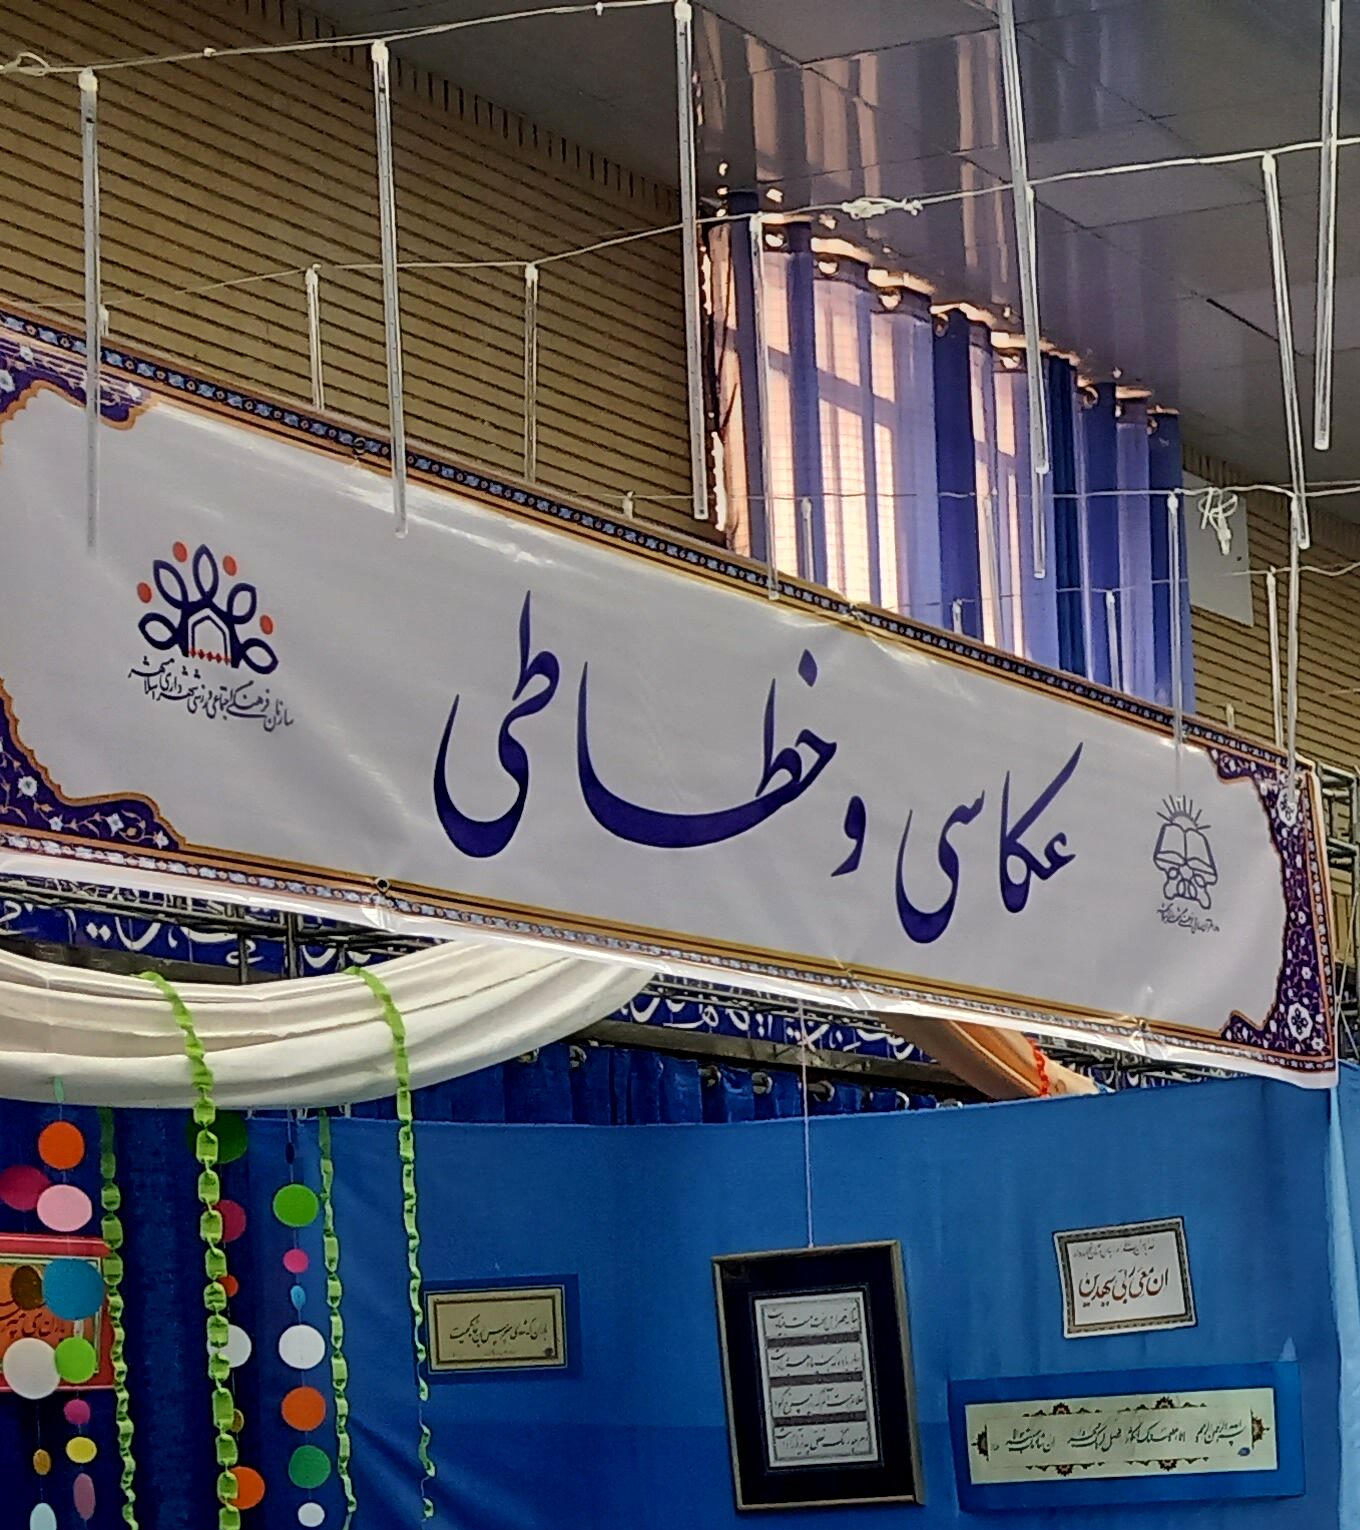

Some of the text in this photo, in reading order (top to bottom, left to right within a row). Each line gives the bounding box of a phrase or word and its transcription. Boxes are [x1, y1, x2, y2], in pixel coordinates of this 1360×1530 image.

[433, 589, 1084, 944] عکاسی و خطاطی
